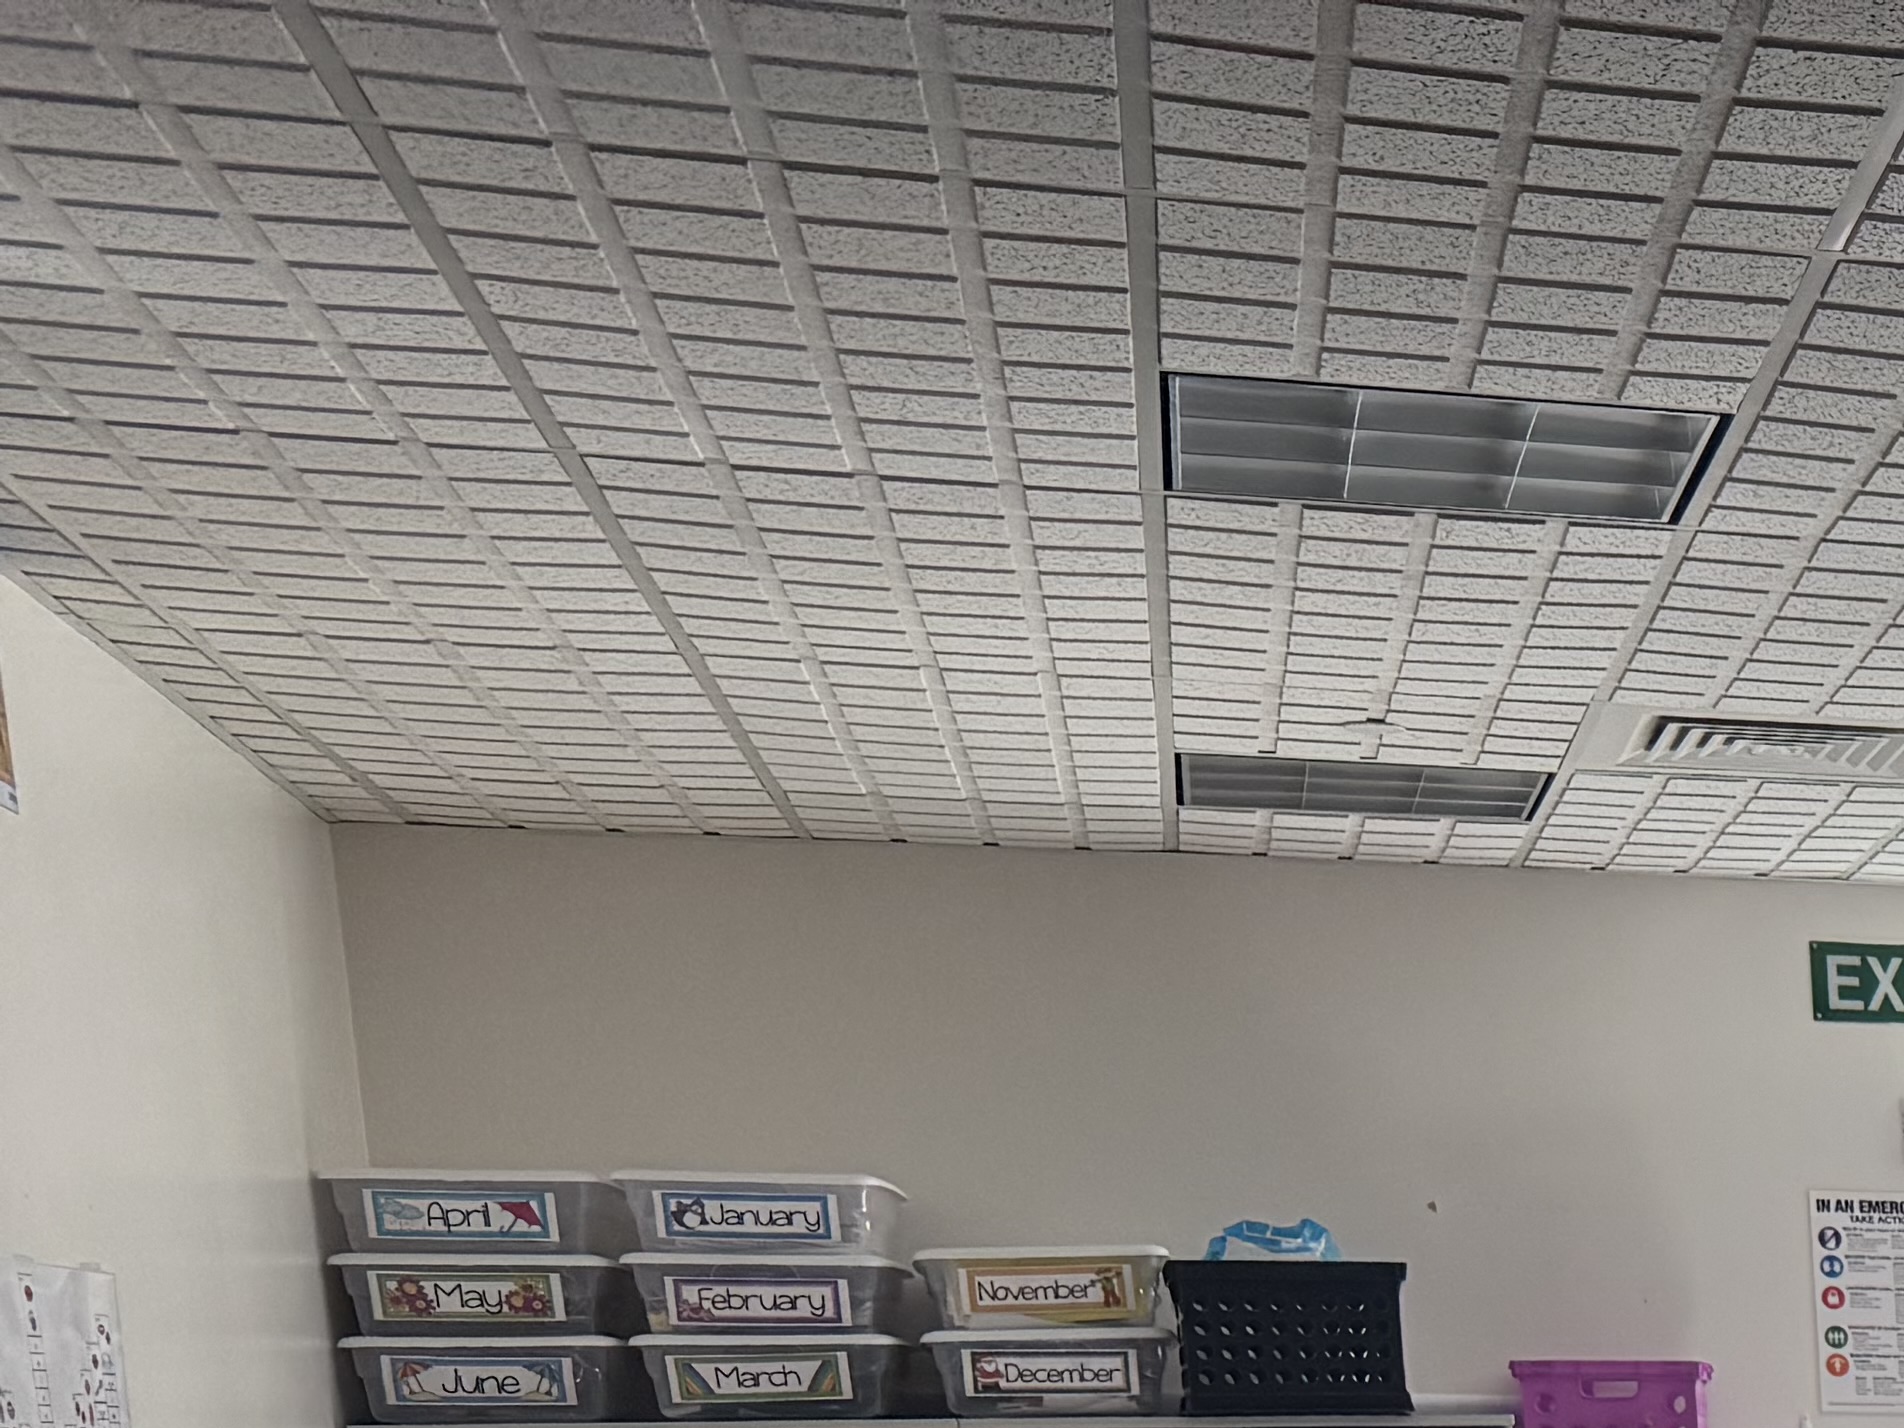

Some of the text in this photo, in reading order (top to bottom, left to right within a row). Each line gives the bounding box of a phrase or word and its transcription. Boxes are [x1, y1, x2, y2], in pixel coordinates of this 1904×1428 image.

[427, 1201, 491, 1233] April
[710, 1202, 821, 1233] January
[1816, 1199, 1831, 1213] IN
[1834, 1199, 1855, 1214] AN
[1849, 1216, 1875, 1224] TAKE
[433, 1283, 503, 1315] May
[698, 1287, 826, 1317] February
[977, 1279, 1095, 1302] November
[442, 1368, 521, 1394] June
[715, 1365, 802, 1389] March
[1004, 1363, 1121, 1384] December
